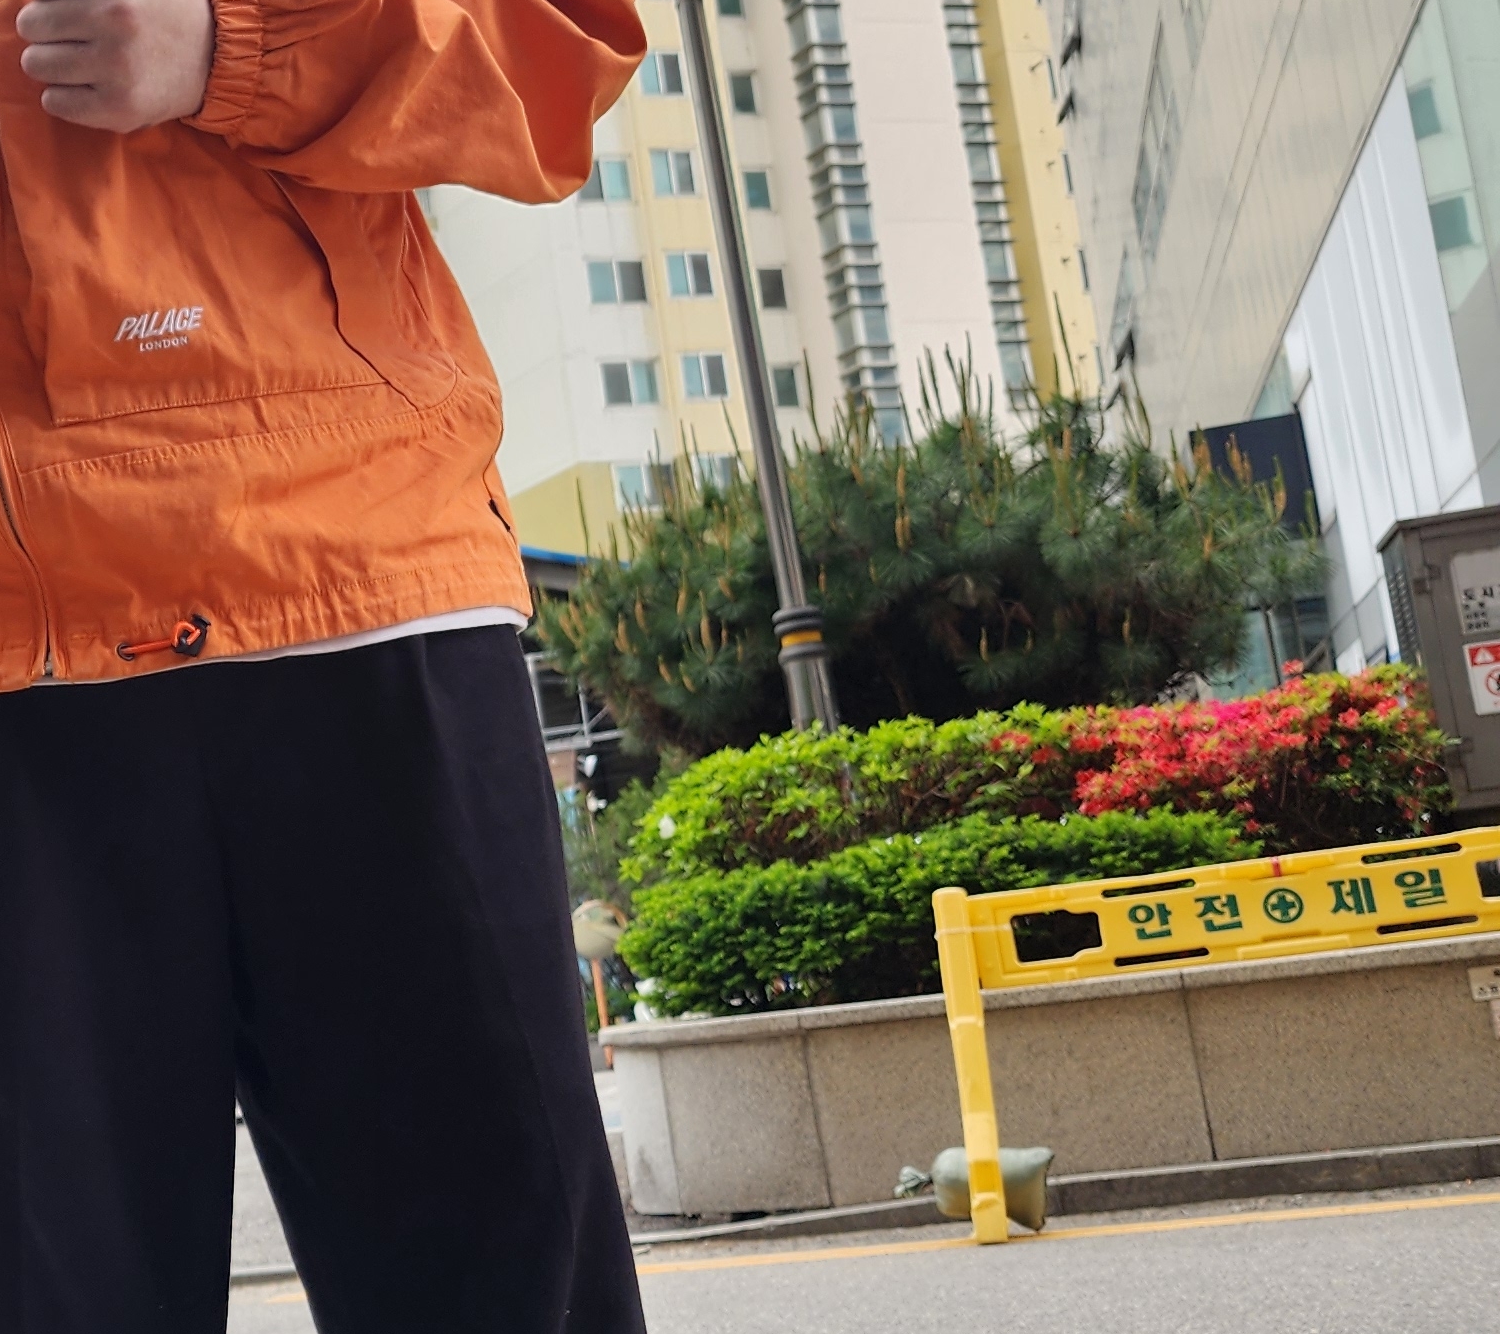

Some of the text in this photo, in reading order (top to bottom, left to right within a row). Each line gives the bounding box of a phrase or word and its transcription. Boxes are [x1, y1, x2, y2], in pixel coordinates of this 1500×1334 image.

[114, 306, 203, 342] PALACE
[139, 336, 188, 352] LONDON
[1128, 868, 1448, 941] 안전 제일
